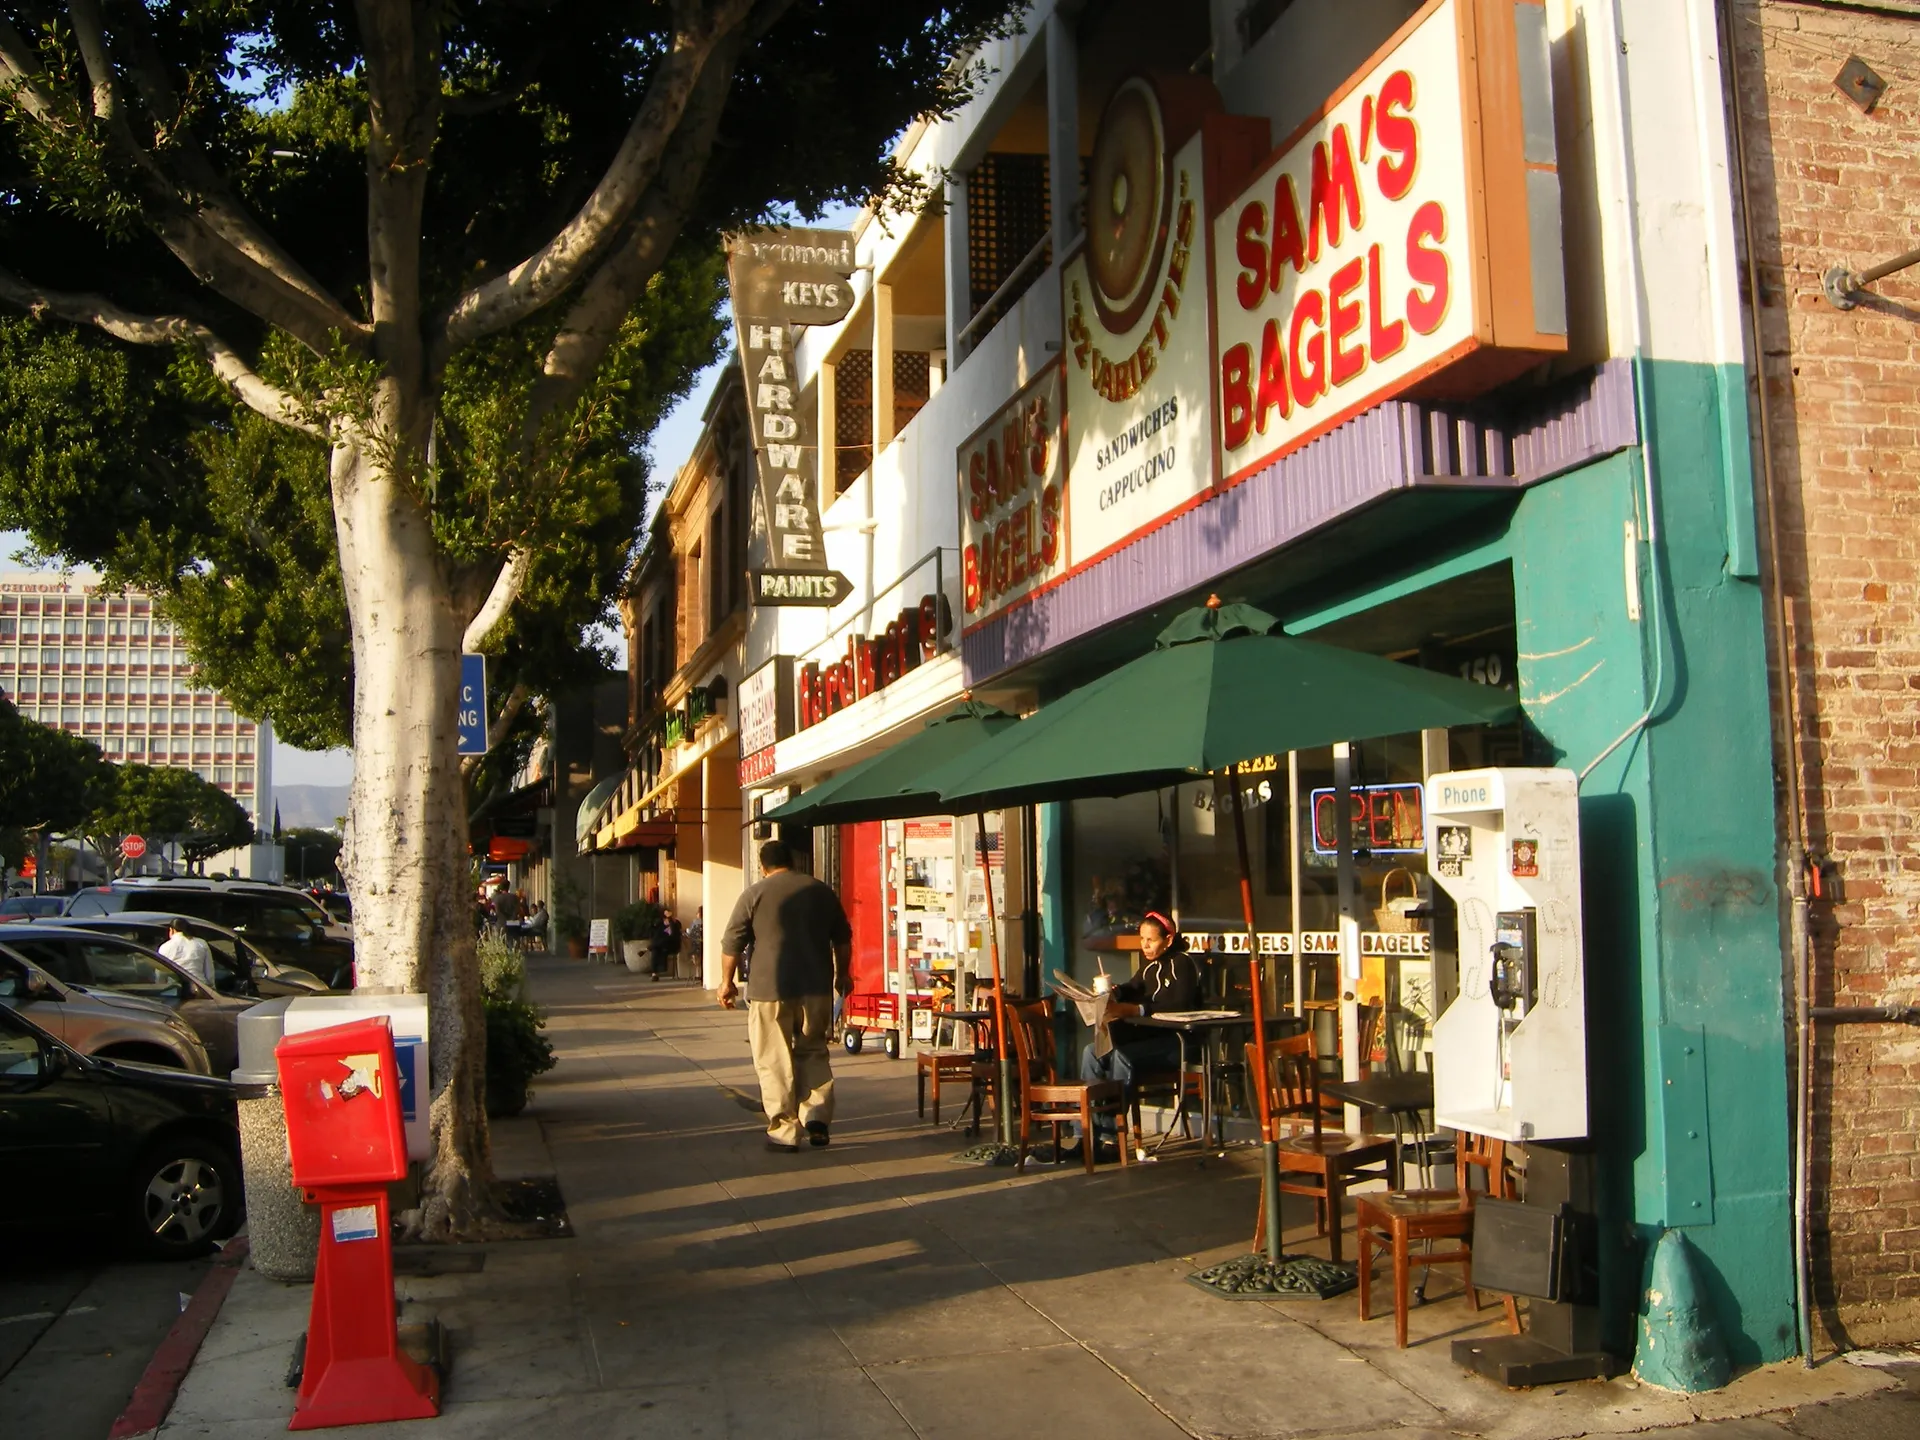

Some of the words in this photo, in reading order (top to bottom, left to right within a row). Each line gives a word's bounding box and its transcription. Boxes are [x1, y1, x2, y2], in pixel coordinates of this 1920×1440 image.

[1236, 70, 1421, 311] SAM'S
[783, 281, 839, 307] KEYS
[1222, 201, 1453, 451] BAGELS
[749, 324, 811, 560] HARDWARE
[969, 396, 1050, 522] SAM'S
[1096, 396, 1179, 471] SANDWICHES
[1099, 446, 1176, 511] CAPPUCCINO
[965, 484, 1060, 613] BAGELS
[761, 574, 838, 598] PAINTS
[1315, 787, 1422, 847] OPEN
[1444, 787, 1486, 805] Phone
[124, 841, 144, 851] STOP
[1363, 934, 1430, 952] BAGELS
